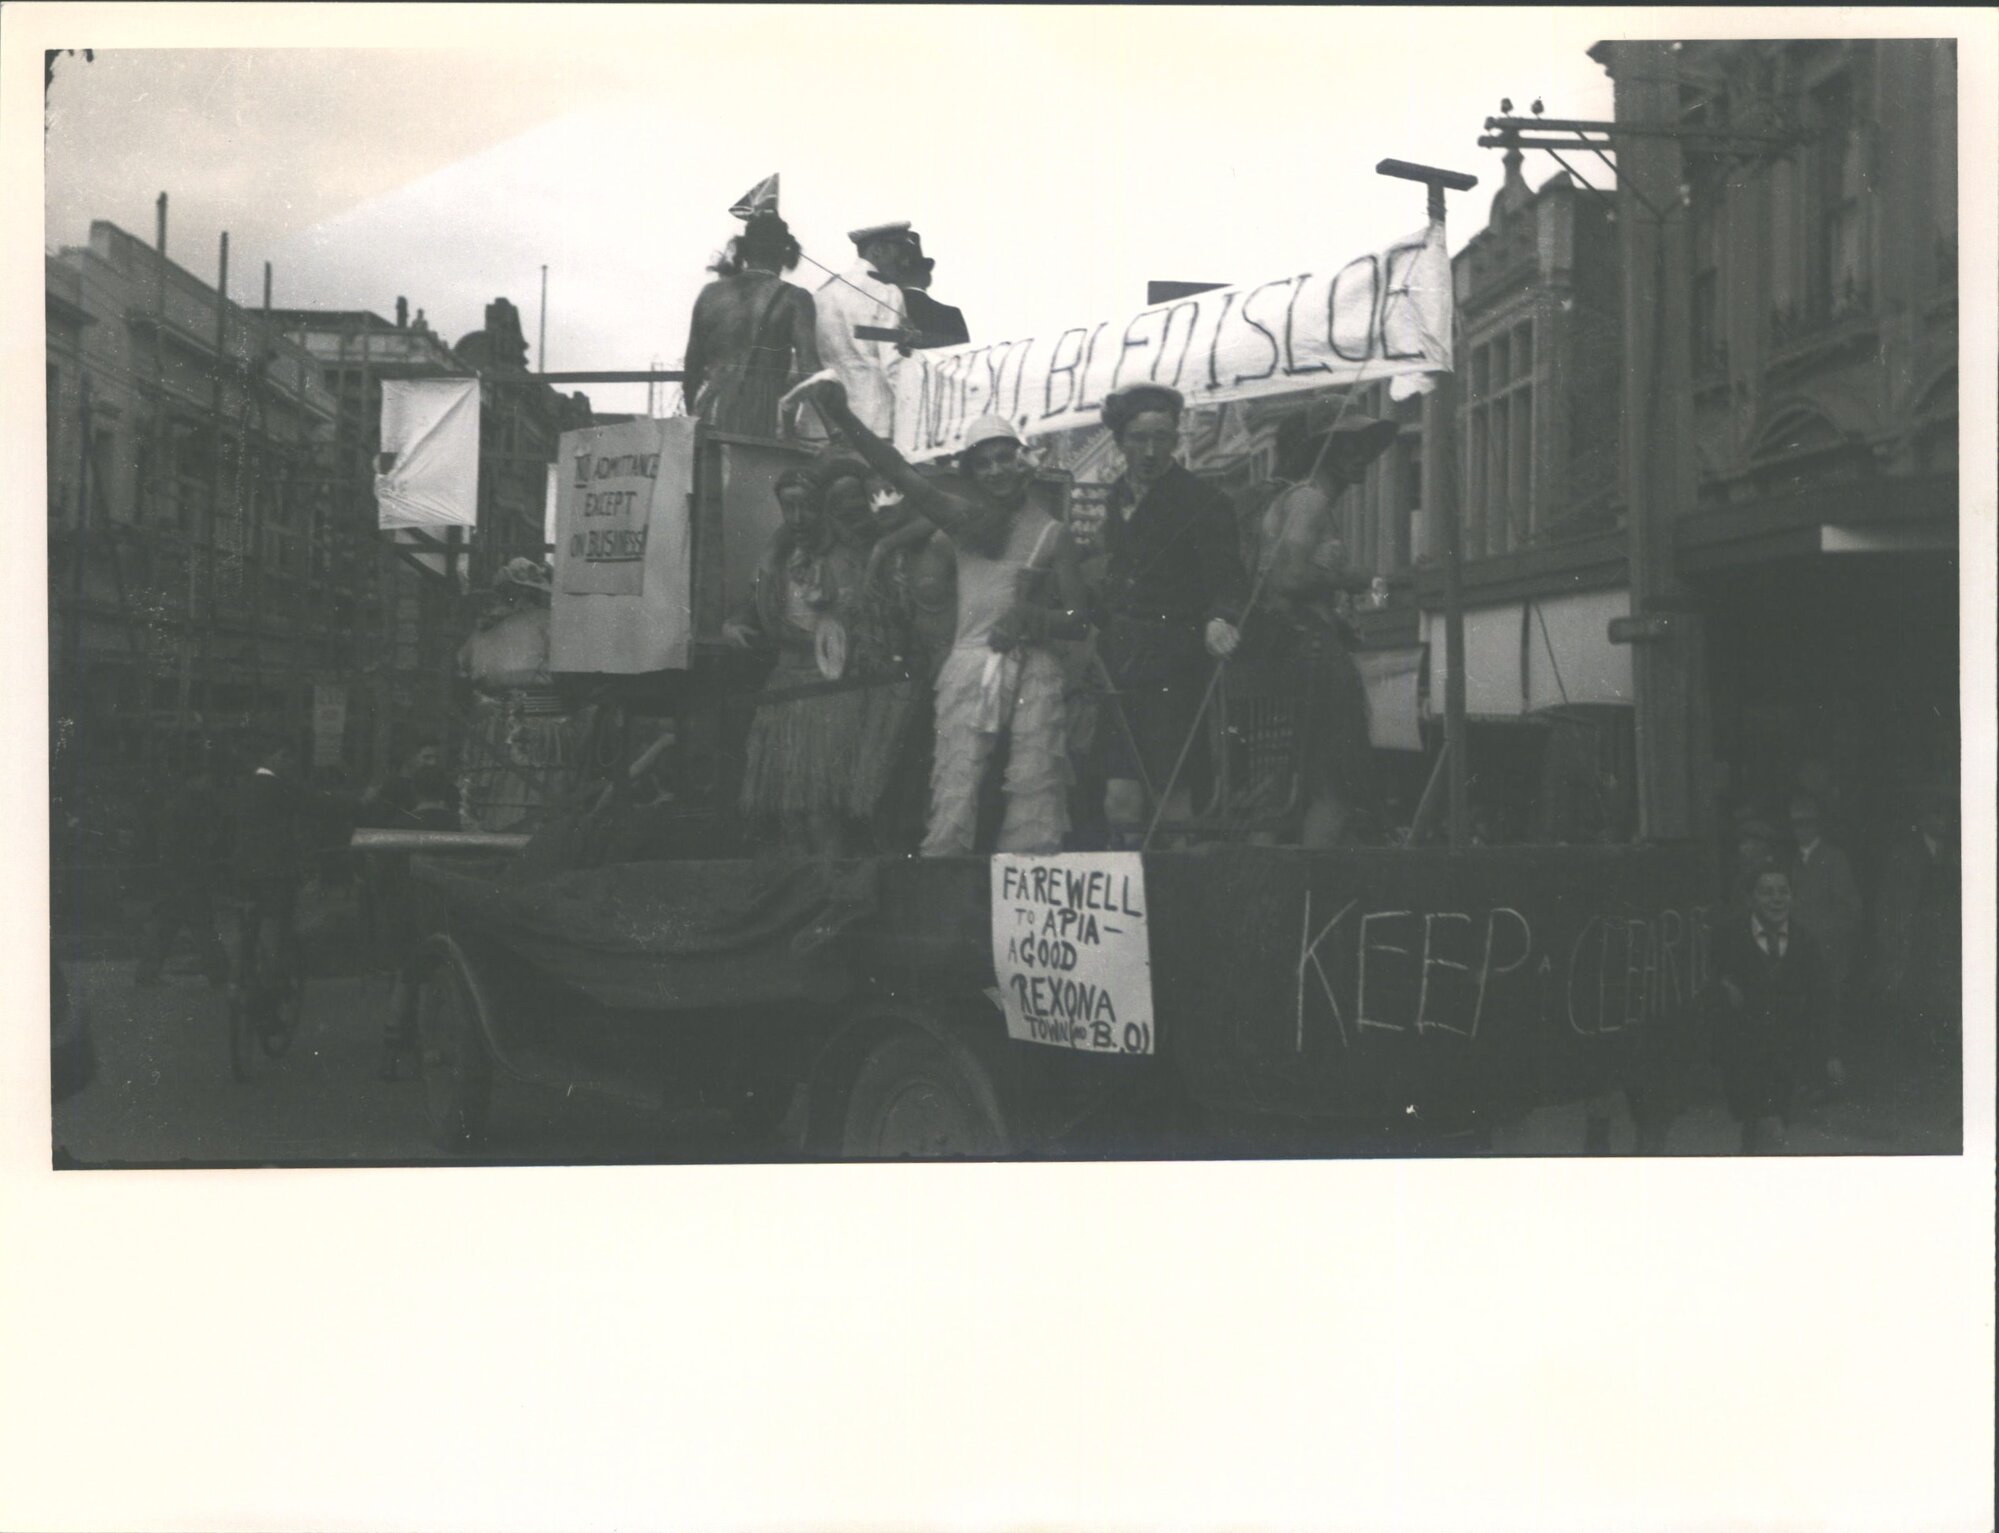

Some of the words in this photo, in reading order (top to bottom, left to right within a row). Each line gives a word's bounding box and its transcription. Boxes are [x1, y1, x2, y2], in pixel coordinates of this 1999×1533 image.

[584, 490, 638, 517] EXCEPT
[570, 532, 586, 558] ON
[1003, 866, 1143, 917] FAREWELL
[1015, 907, 1036, 926] TO
[1008, 936, 1019, 964] A
[1019, 930, 1079, 972] GOOD
[1295, 889, 1532, 1053] KEEP
[1009, 973, 1117, 1024] REXONA
[1023, 1015, 1068, 1043] TOWN
